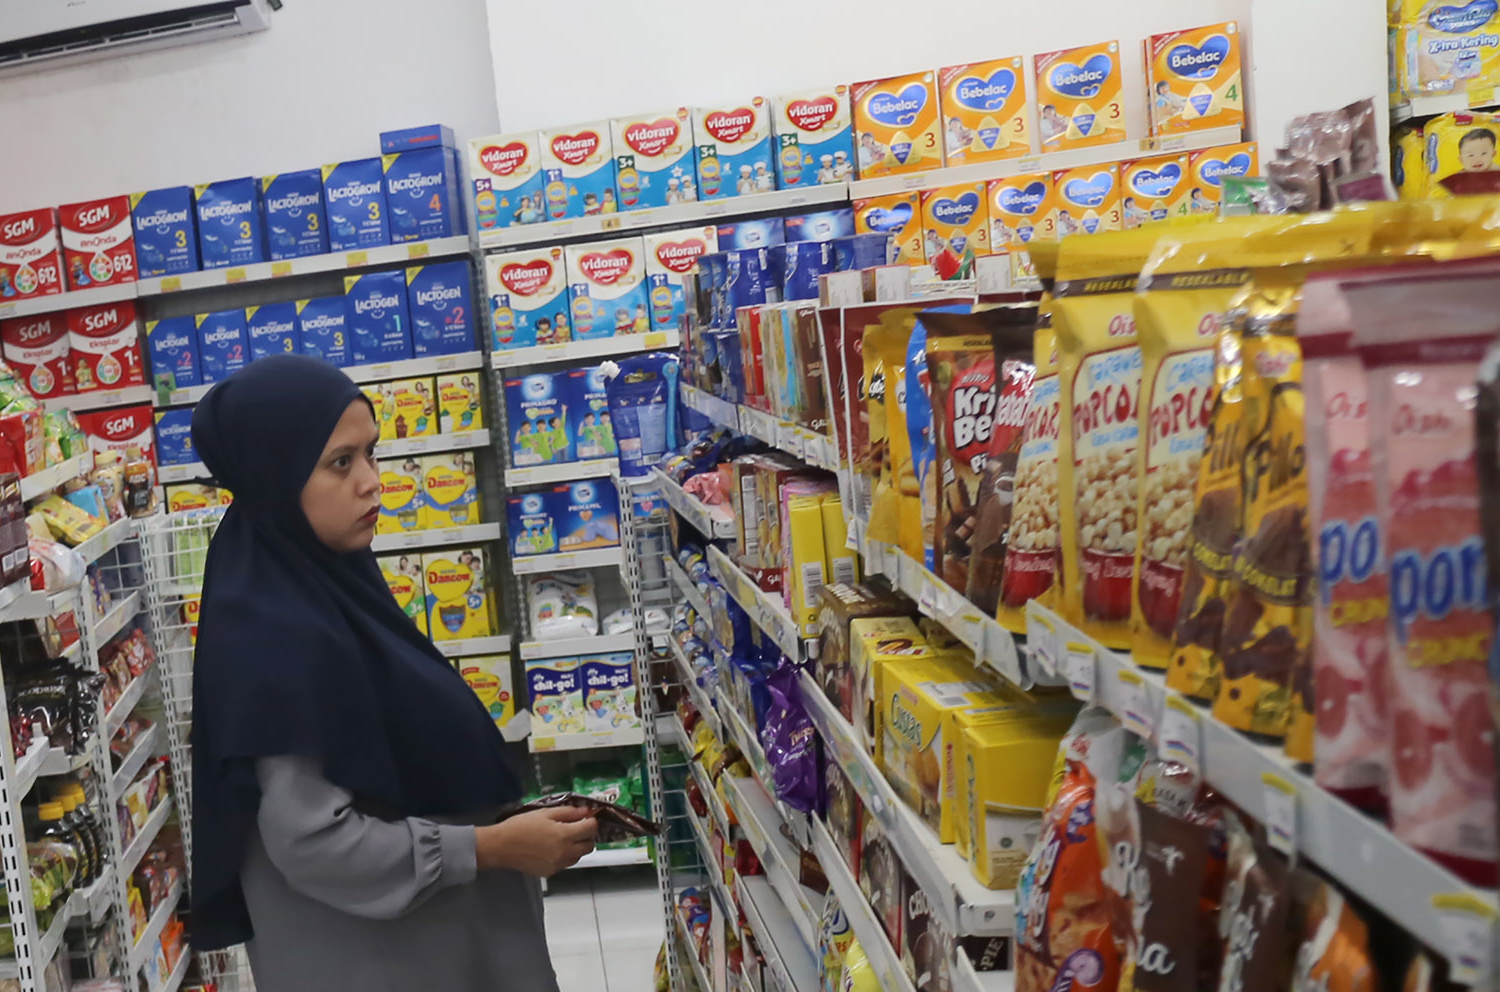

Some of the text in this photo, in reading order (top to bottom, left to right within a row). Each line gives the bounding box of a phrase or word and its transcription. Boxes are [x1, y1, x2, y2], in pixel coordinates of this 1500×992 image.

[1460, 33, 1500, 49] Kering
[1171, 48, 1221, 68] Bebelac
[1054, 68, 1103, 87] Bebelac
[960, 82, 1008, 100] Bebelac
[1225, 84, 1238, 102] 4
[789, 103, 834, 117] vidoran
[872, 97, 919, 115] Bebelac
[1108, 103, 1120, 119] 3
[706, 114, 751, 129] vidoran
[1013, 117, 1025, 132] 3
[627, 125, 676, 142] vidoran
[782, 134, 797, 145] 3+
[924, 132, 936, 148] 3
[552, 135, 596, 152] vidoran
[700, 146, 715, 157] 3+
[481, 146, 525, 163] vidoran
[619, 157, 634, 168] 3+
[1204, 164, 1244, 178] Bebelac
[328, 181, 381, 202] LACTOGROW
[388, 172, 443, 194] LACTOGROW
[476, 181, 491, 191] 5+
[368, 202, 380, 220] 3
[429, 193, 441, 212] 4
[935, 203, 973, 217] Bebelac
[1178, 202, 1188, 215] 4
[79, 205, 111, 227] SGM
[307, 213, 319, 231] 3
[1045, 218, 1054, 231] 3
[1110, 210, 1120, 223] 3
[4, 217, 34, 239] SGM
[239, 221, 252, 239] 3
[977, 229, 987, 242] 3
[175, 230, 187, 248] 3
[912, 238, 921, 251] 3
[658, 243, 703, 260] vidoran
[582, 255, 629, 271] vidoran
[502, 264, 549, 282] vidoran
[416, 286, 461, 306] LACTOGEN
[85, 308, 118, 331] SGM
[452, 306, 465, 324] 2
[19, 320, 51, 342] SGM
[1108, 314, 1138, 337] Ois
[283, 337, 293, 352] 3
[334, 331, 344, 346] 3
[953, 384, 996, 419] Kri
[1325, 391, 1368, 420] Ois
[105, 415, 135, 435] SGM
[1151, 386, 1214, 447] POPCO
[952, 413, 993, 451] Be
